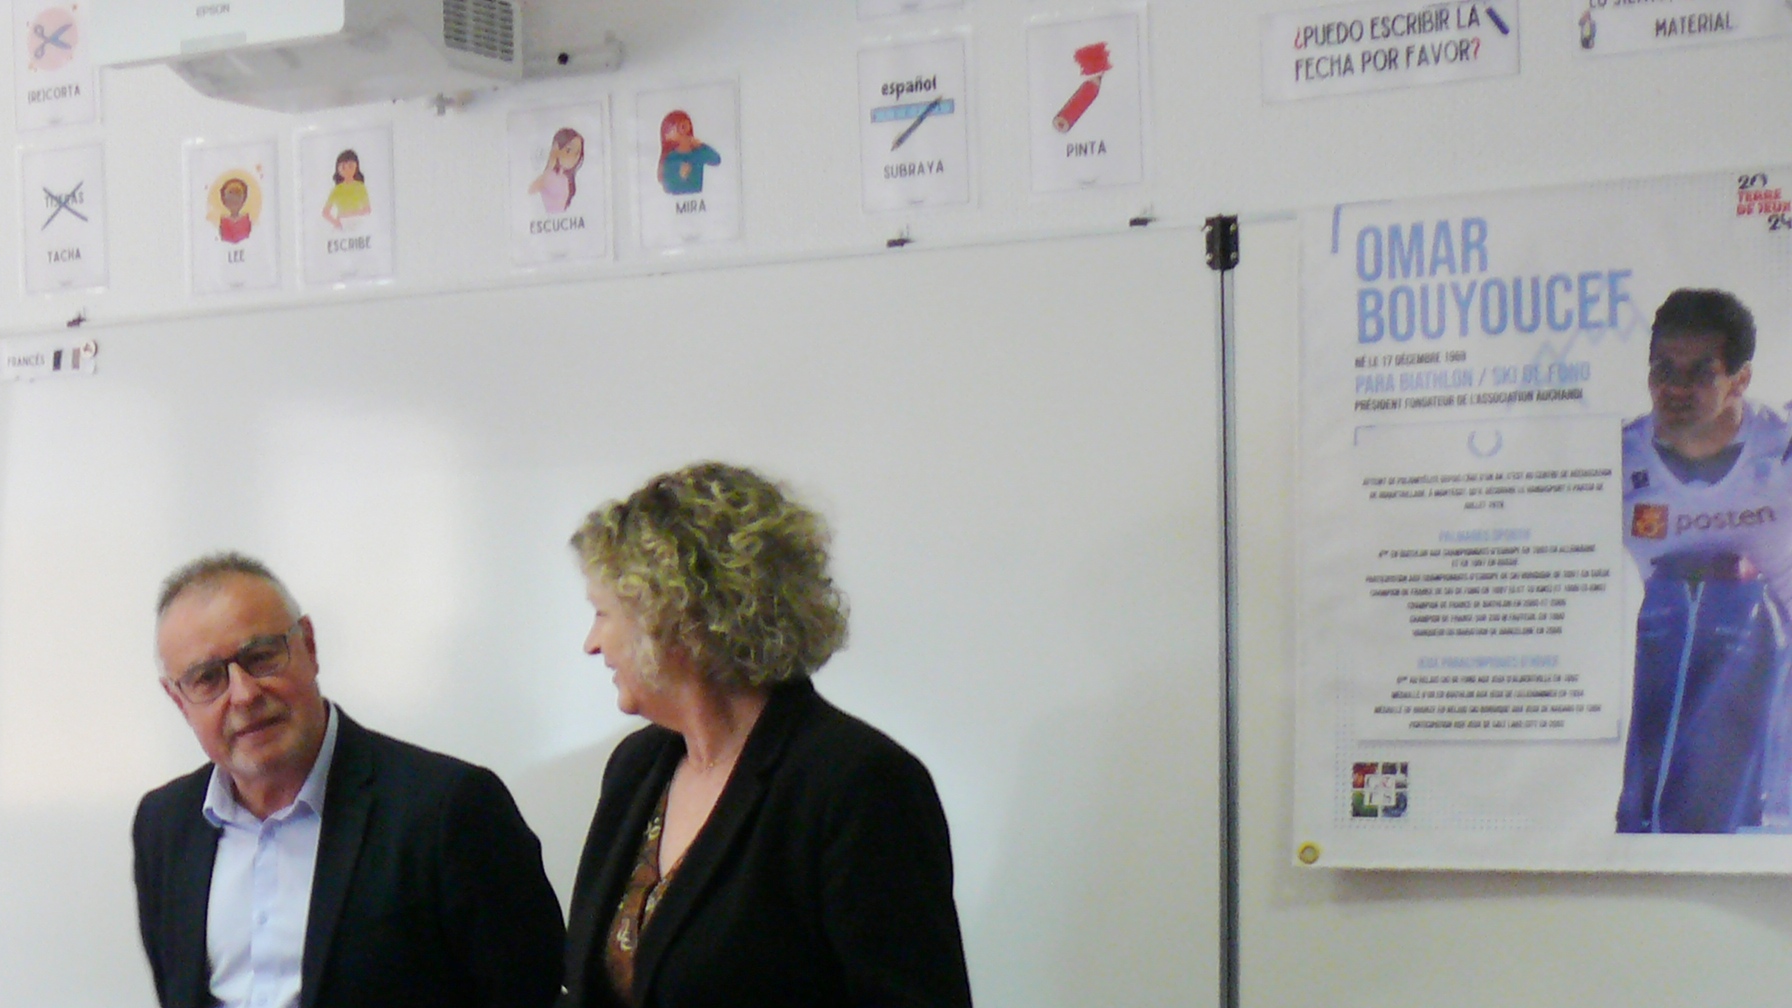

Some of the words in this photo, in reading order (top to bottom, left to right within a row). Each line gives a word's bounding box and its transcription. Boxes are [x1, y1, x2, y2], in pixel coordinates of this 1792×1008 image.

[1294, 18, 1364, 49] ¿PUEDO
[1370, 10, 1451, 40] ESCRIBIR
[1456, 4, 1480, 28] LA
[1655, 11, 1734, 37] MATERIAL
[1294, 48, 1354, 82] FECHA
[1361, 46, 1399, 72] POR
[1405, 38, 1481, 68] FAVOR?
[27, 84, 81, 105] (RE)CORTA
[880, 75, 938, 98] español
[1066, 140, 1108, 159] PINTA
[883, 159, 946, 180] SUBRAYA
[675, 200, 707, 216] MIRA
[529, 216, 586, 234] ESCUCHA
[47, 247, 81, 264] TACHA
[327, 235, 372, 254] ESCRIBE
[1355, 216, 1489, 282] OMAR
[227, 249, 245, 264] LEE
[1356, 269, 1634, 345] BOUYOUCEF
[1355, 372, 1395, 394] PARA
[1399, 367, 1473, 392] BIATHLON
[1675, 505, 1777, 535] posten
